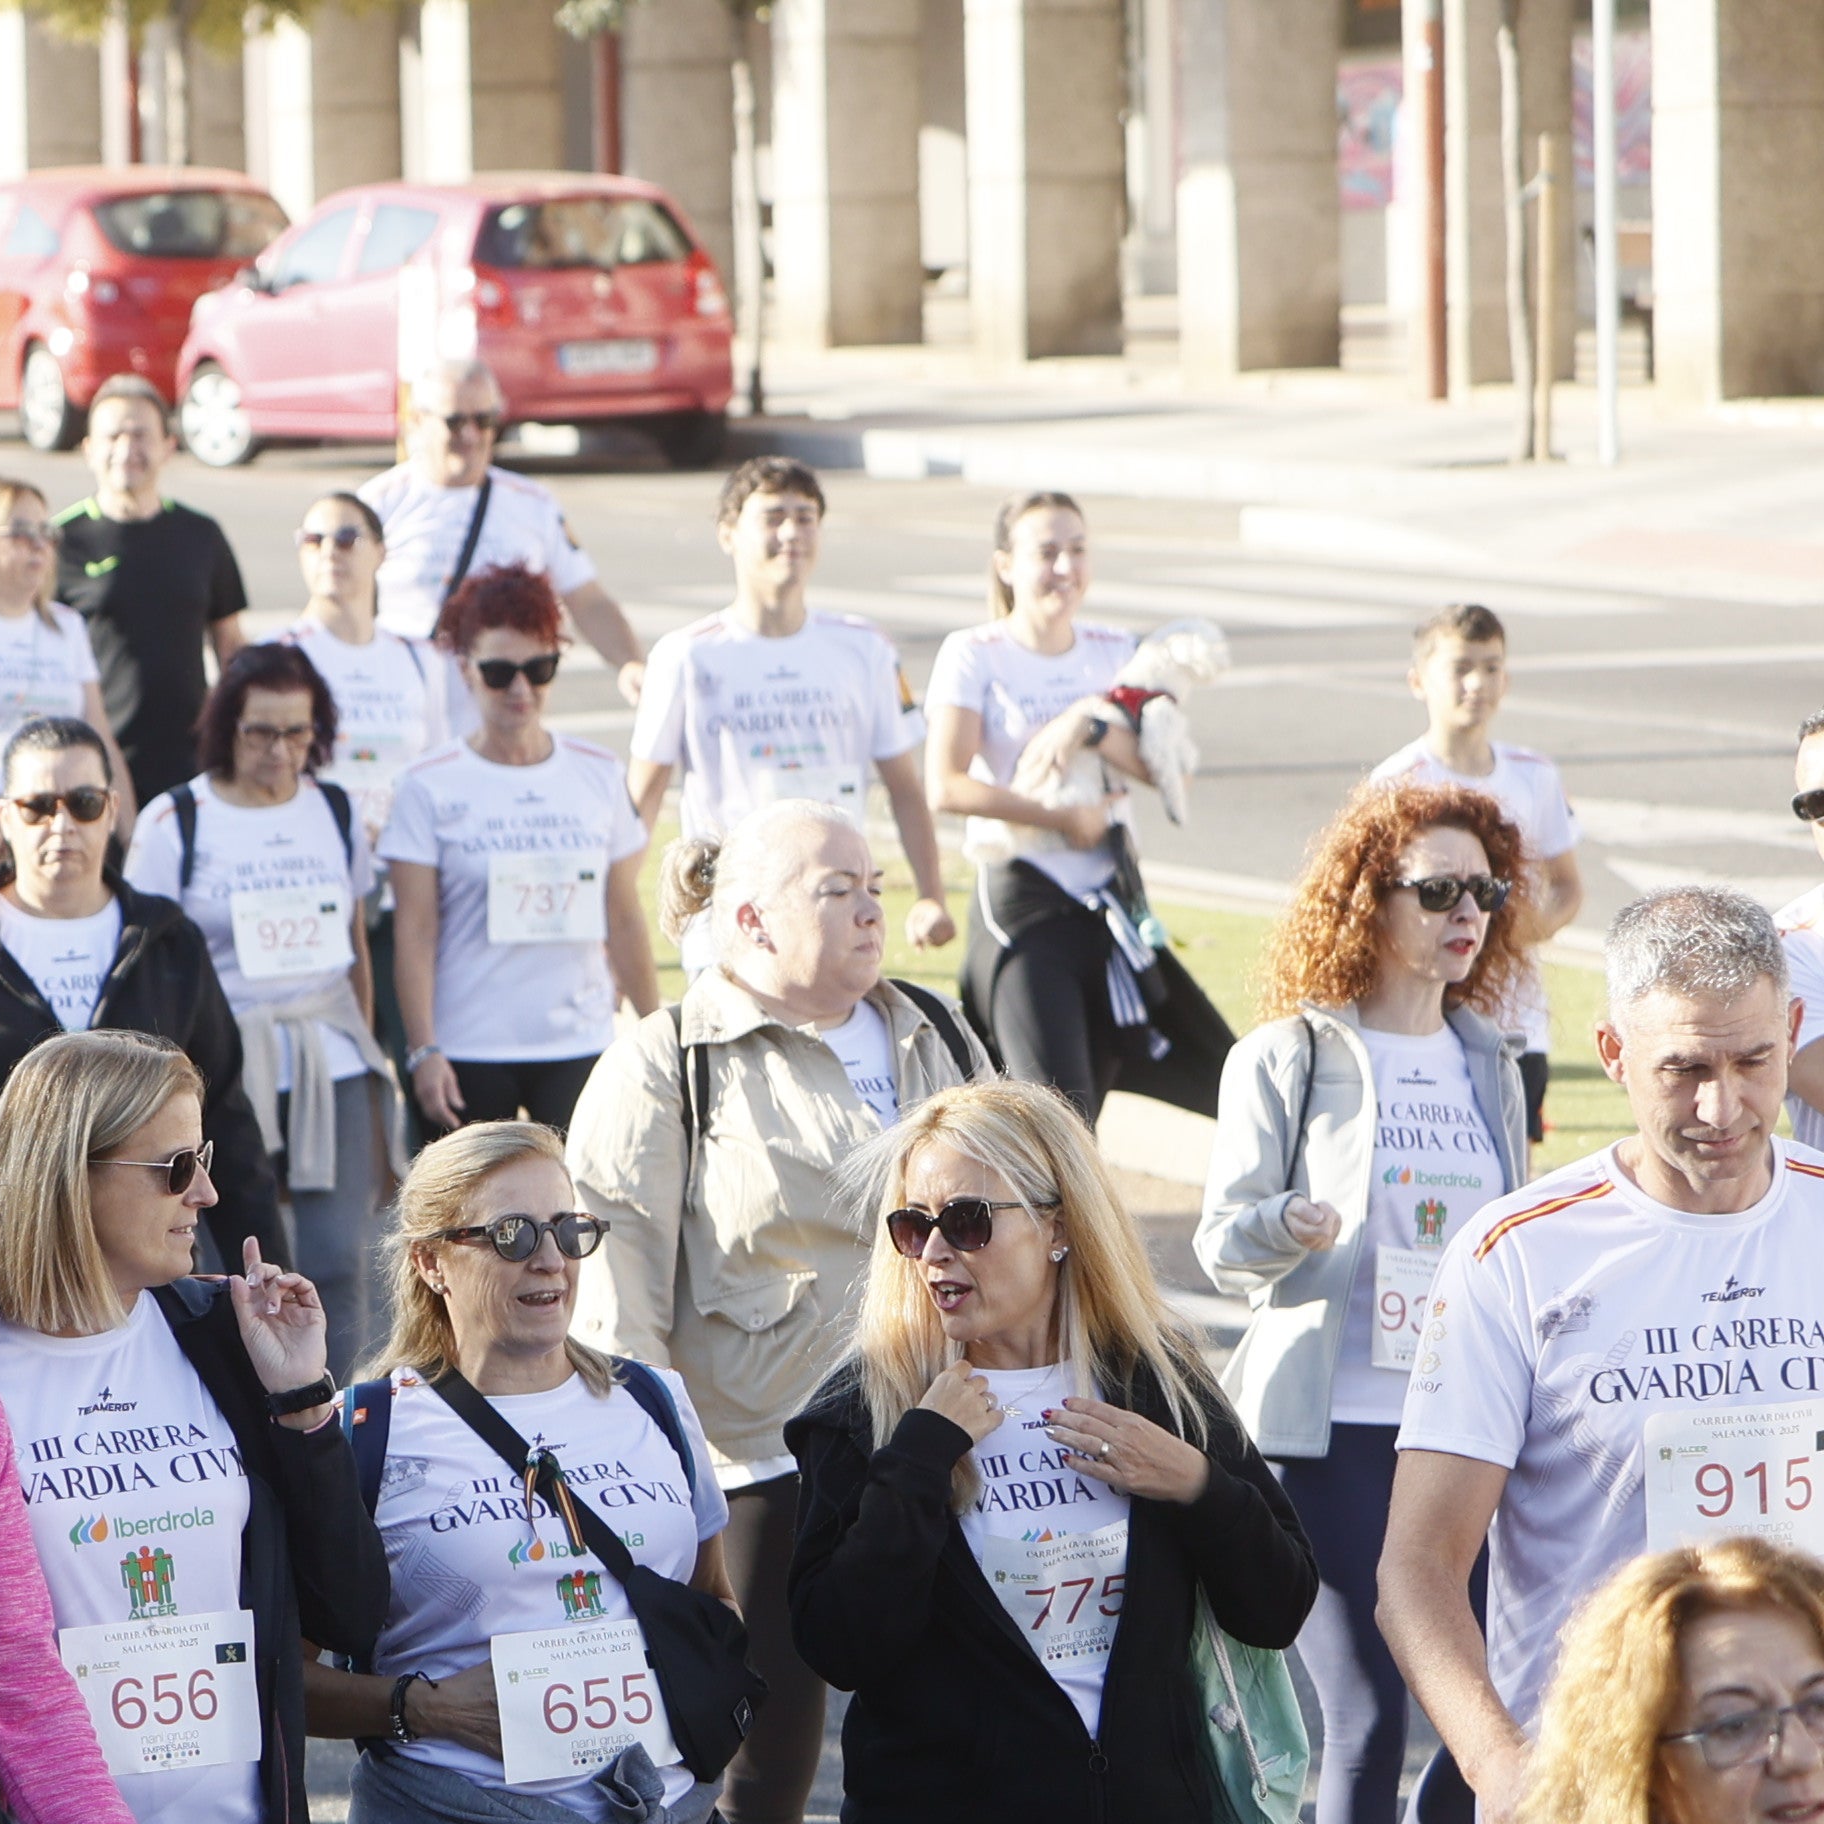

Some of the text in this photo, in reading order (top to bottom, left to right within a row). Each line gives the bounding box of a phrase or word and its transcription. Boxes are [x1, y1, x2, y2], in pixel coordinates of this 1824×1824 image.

[514, 883, 577, 917] 737
[257, 916, 323, 950] 922
[1392, 1102, 1476, 1128] CARRERA
[1414, 1170, 1482, 1190] Iberdrola
[1644, 1327, 1680, 1355] III
[78, 1401, 137, 1416] TEAMERGY
[31, 1423, 209, 1463] III CARRERA
[472, 1477, 500, 1494] III
[599, 1481, 687, 1508] CIVIL
[1695, 1457, 1812, 1518] 915
[114, 1506, 214, 1538] Iberdrola
[128, 1603, 178, 1620] ALCER
[1025, 1573, 1125, 1630] 775
[179, 1638, 198, 1648] 2025
[1073, 1625, 1108, 1641] grupo
[611, 1643, 631, 1652] 2025
[1047, 1636, 1108, 1654] EMPRESARIAL
[112, 1669, 218, 1729] 656
[543, 1673, 652, 1734] 655
[167, 1729, 199, 1742] grupo
[571, 1733, 635, 1749] nani grupo
[142, 1742, 200, 1754] EMPRESARIAL
